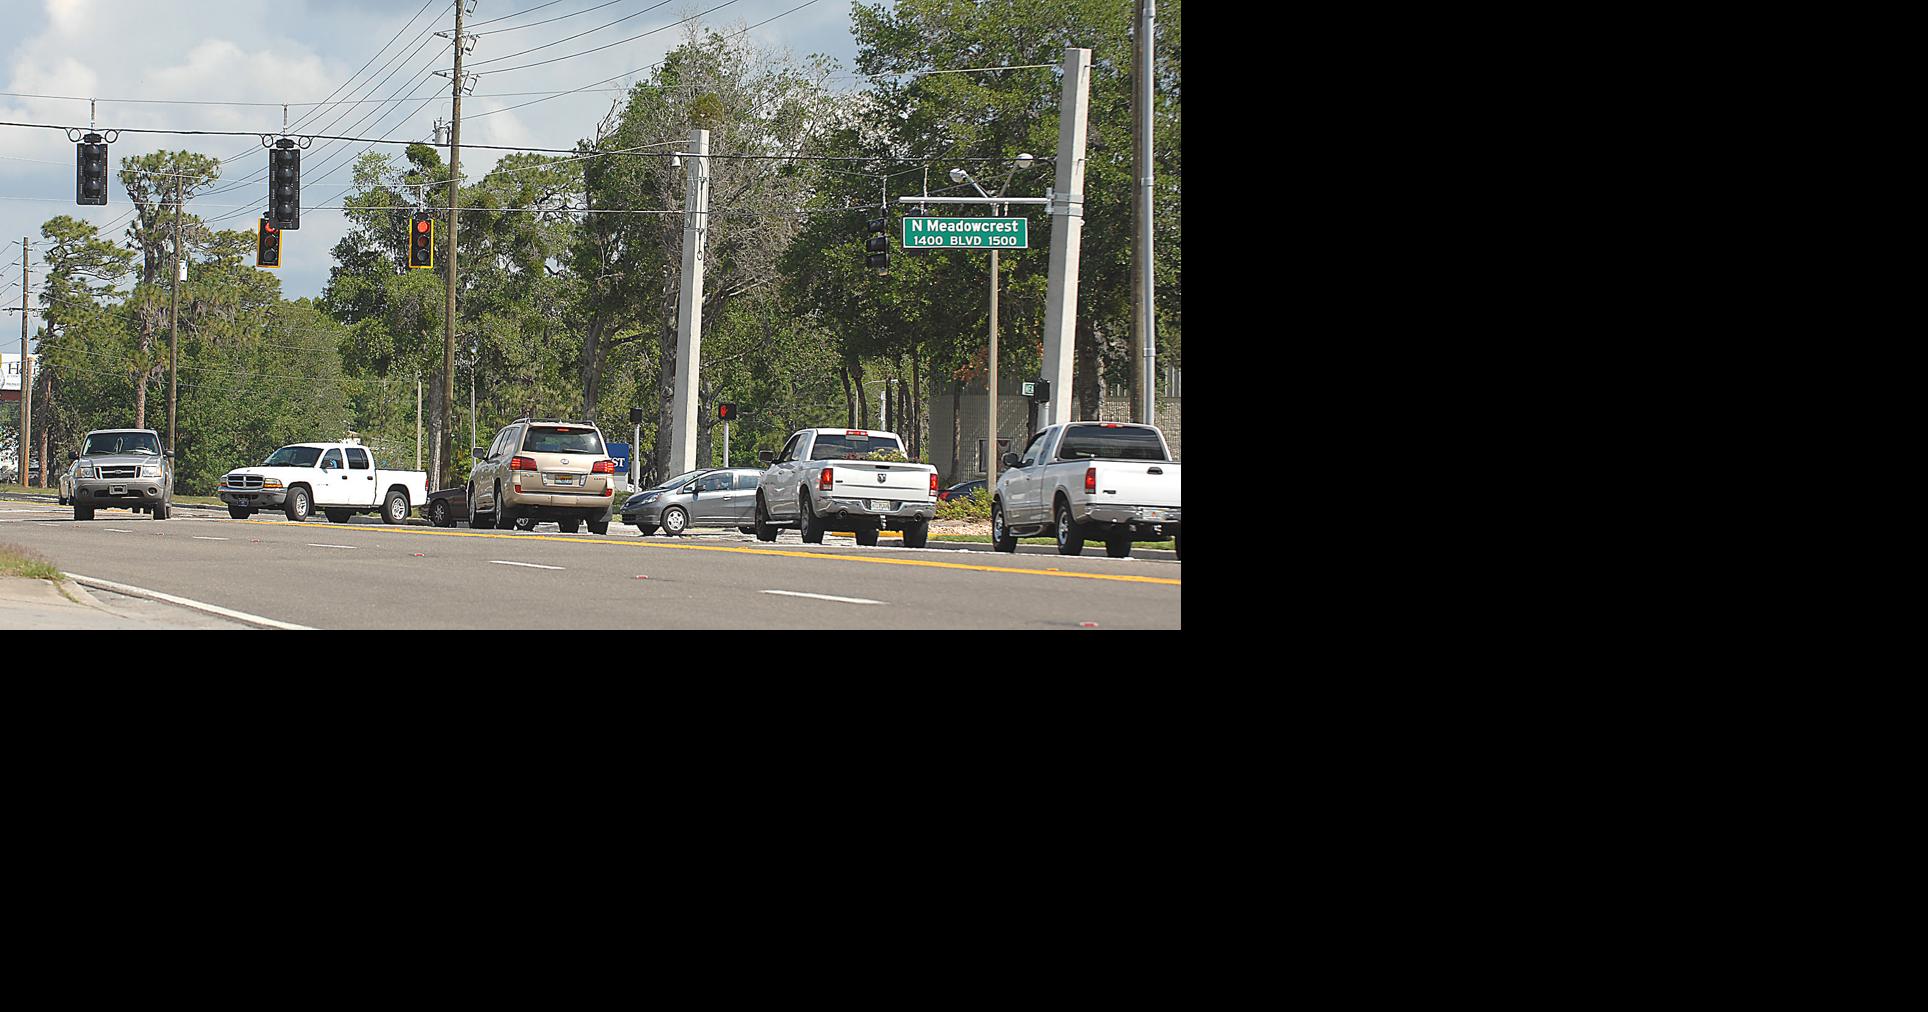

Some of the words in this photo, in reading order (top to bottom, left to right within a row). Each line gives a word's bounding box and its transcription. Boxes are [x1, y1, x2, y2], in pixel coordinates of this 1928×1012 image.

[911, 219, 923, 232] N
[927, 219, 1019, 233] Meadowcrest
[913, 235, 944, 246] 1400
[950, 235, 982, 246] BLVD
[988, 235, 1017, 246] 1500
[610, 457, 626, 468] ST
